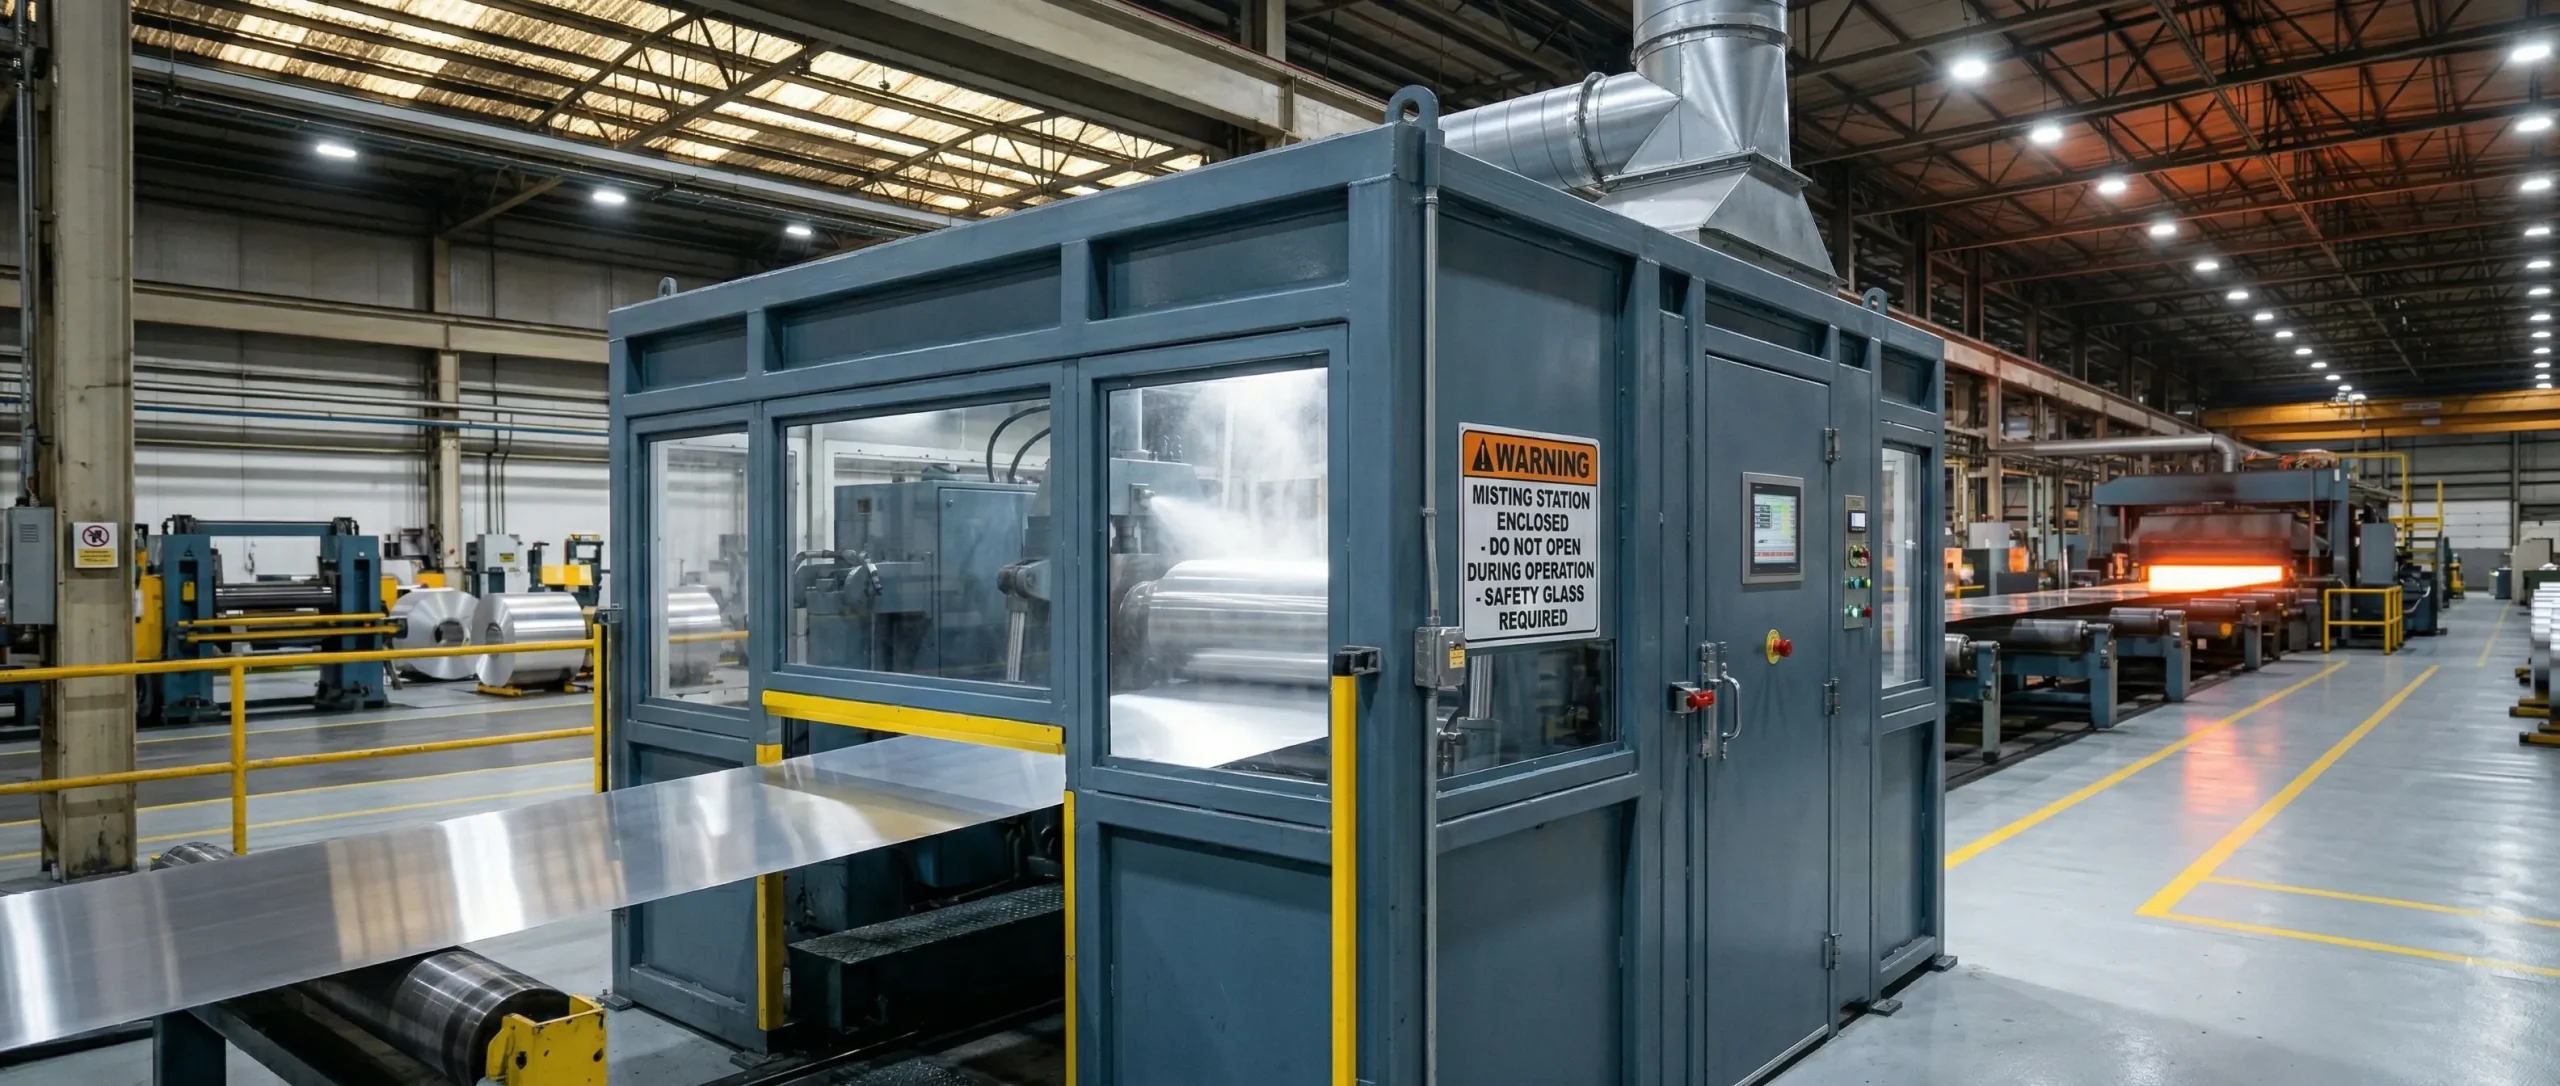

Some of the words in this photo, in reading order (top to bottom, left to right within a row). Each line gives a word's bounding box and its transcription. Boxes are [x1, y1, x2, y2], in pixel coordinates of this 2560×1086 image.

[1495, 442, 1590, 479] WARNING
[1472, 484, 1533, 507] MISTING
[1537, 489, 1590, 510] STATION
[1497, 511, 1569, 532] ENCLOSED
[1489, 537, 1510, 556] DO
[1514, 537, 1543, 556] NOT
[1546, 538, 1581, 556] OPEN
[1467, 562, 1521, 582] DURING
[1525, 561, 1594, 581] OPERATION
[1484, 586, 1539, 606] SAFETY
[1543, 584, 1585, 604] GLASS
[1499, 608, 1568, 631] REQUIRED
